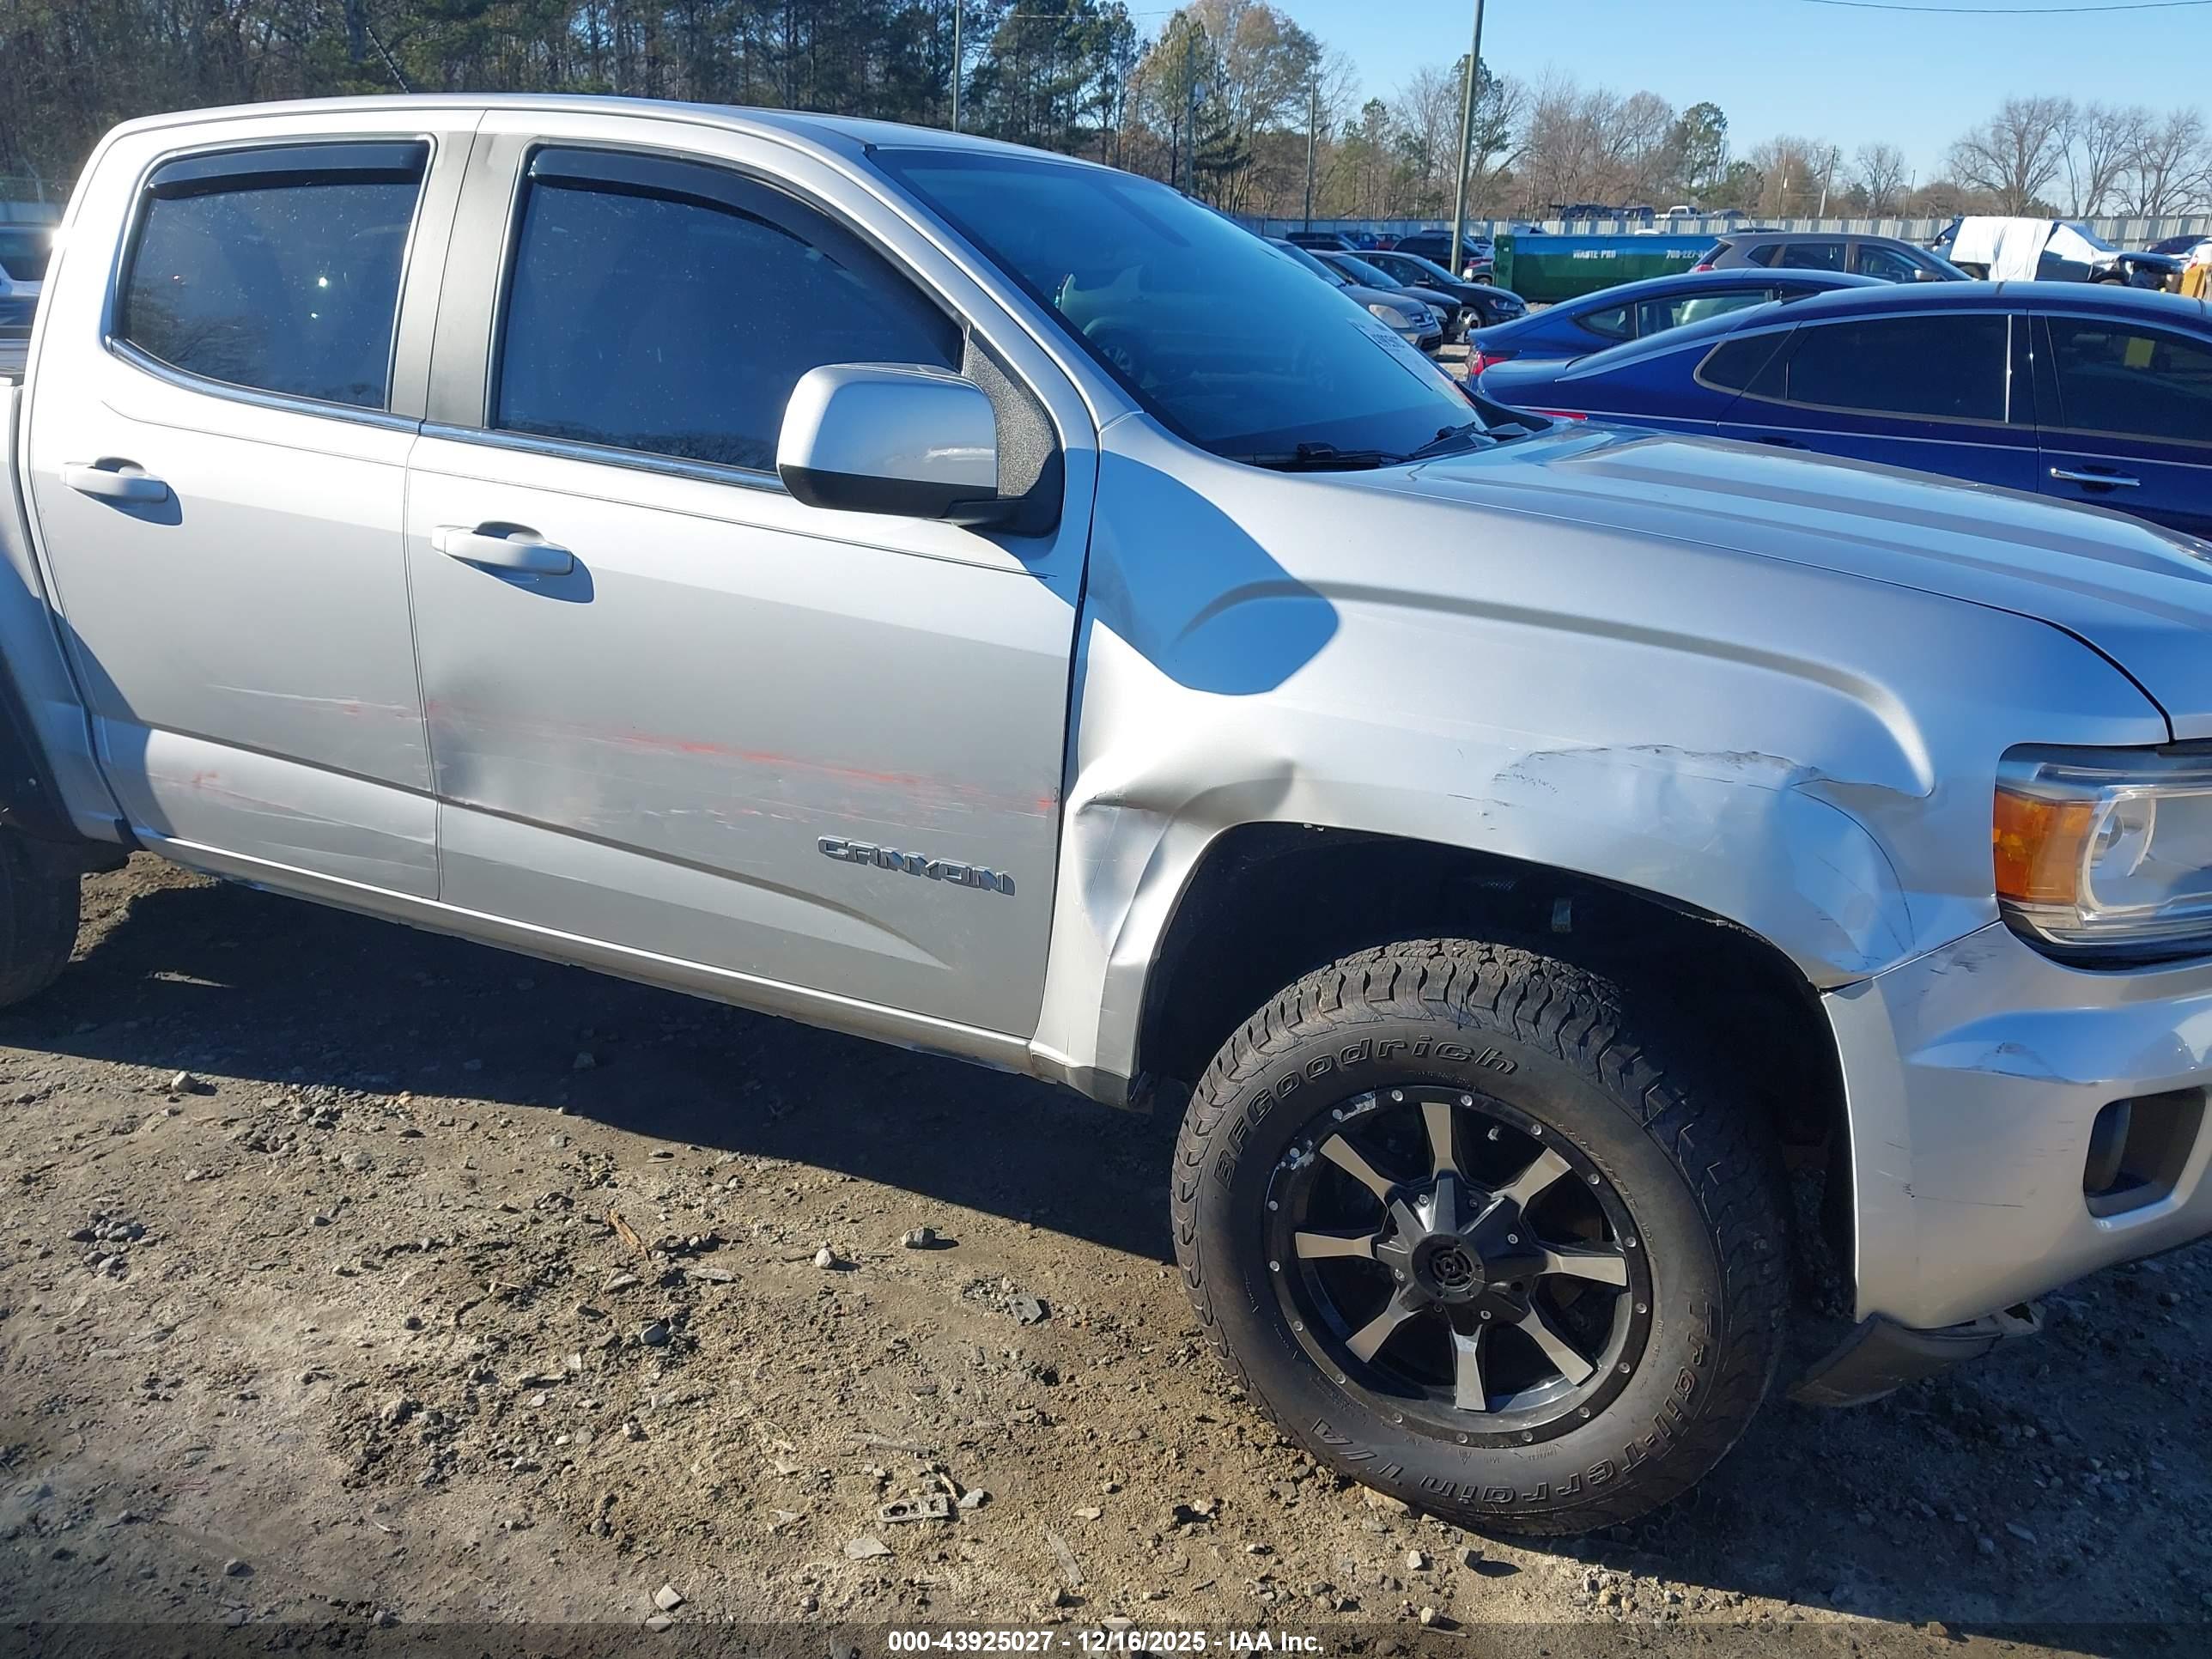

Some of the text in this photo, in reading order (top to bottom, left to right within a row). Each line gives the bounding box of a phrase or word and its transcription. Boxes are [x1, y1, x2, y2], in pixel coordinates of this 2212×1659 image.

[1572, 249, 1617, 259] WASTE PRO
[817, 835, 1016, 896] CANYON
[1213, 1034, 1520, 1190] BFGoodrich
